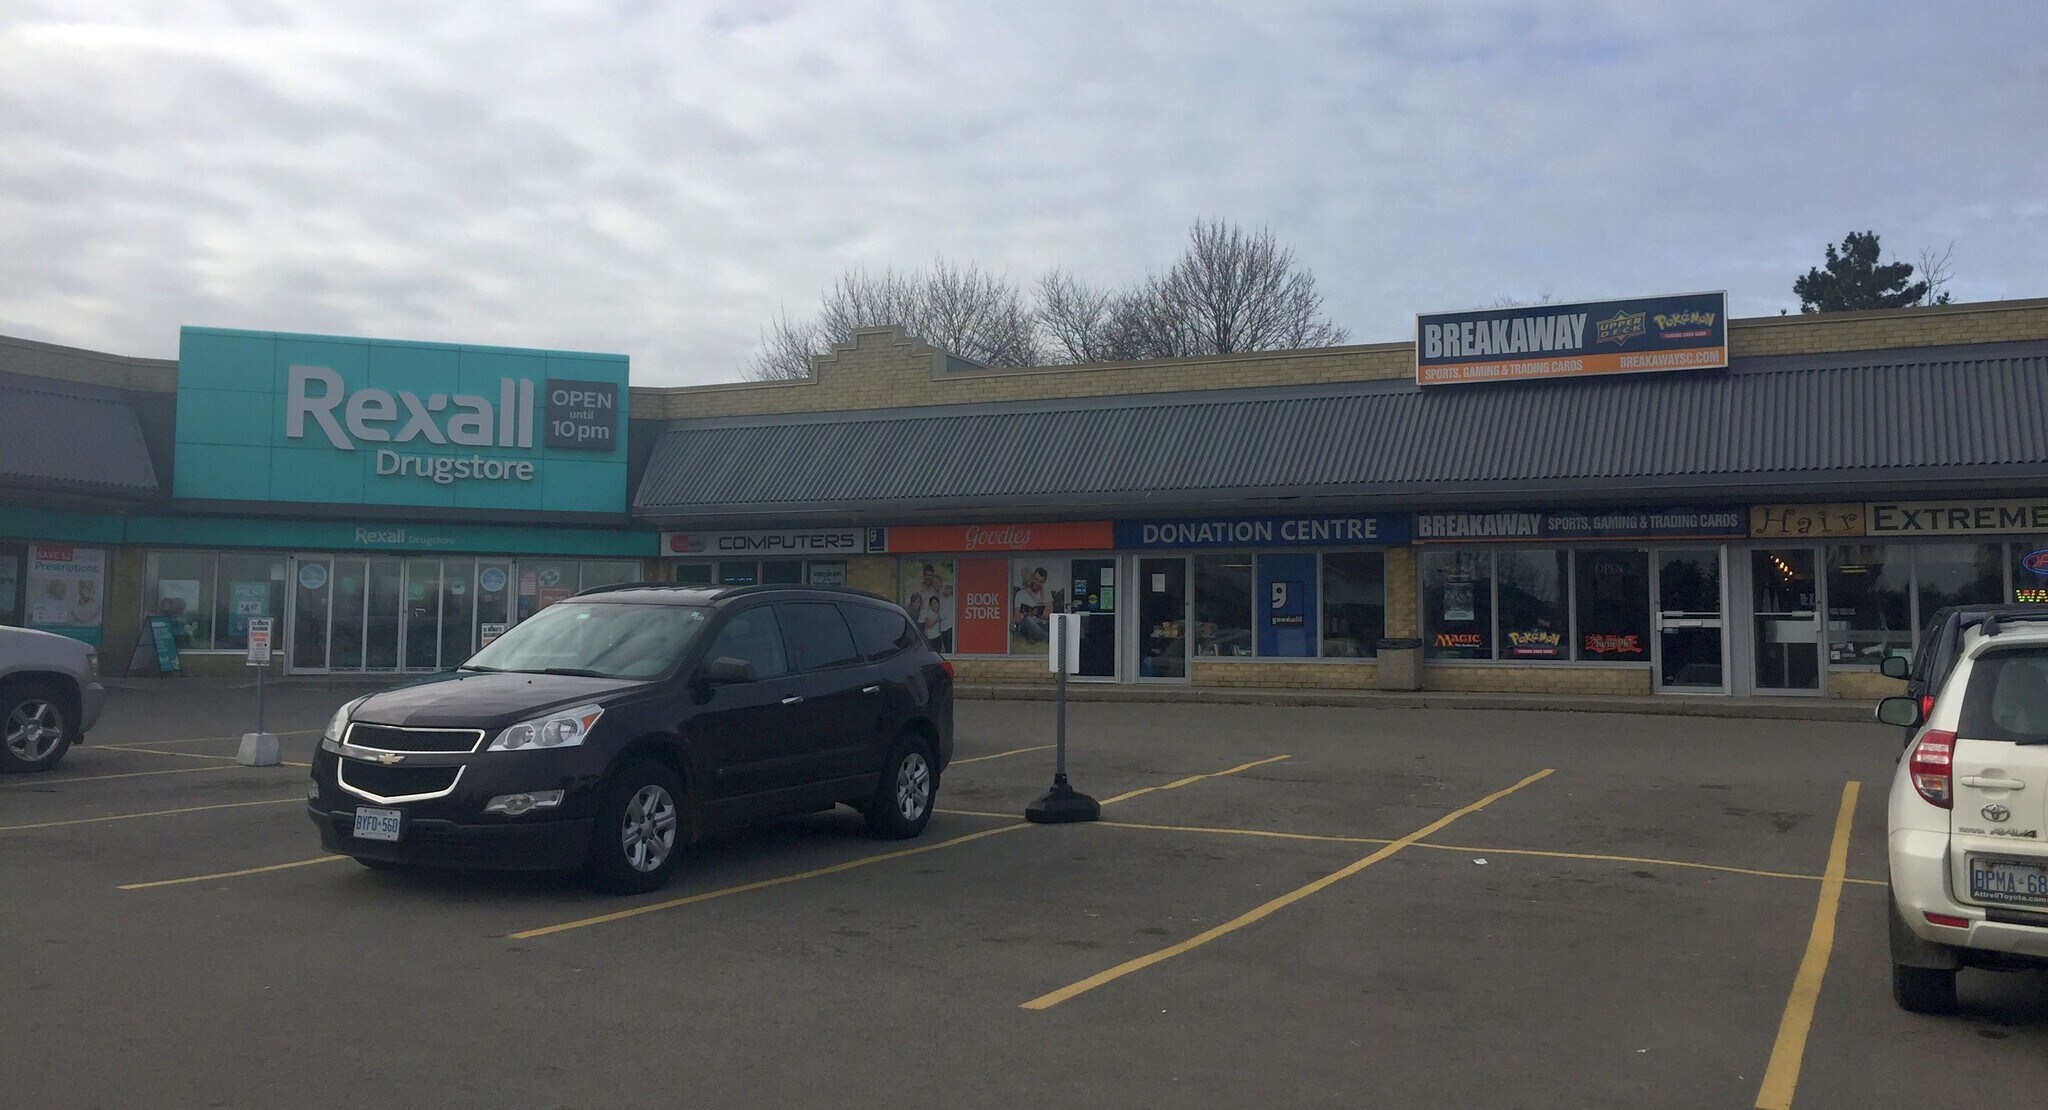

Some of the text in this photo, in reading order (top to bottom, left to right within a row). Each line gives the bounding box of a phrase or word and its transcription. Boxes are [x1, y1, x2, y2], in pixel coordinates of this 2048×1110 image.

[1600, 317, 1641, 331] UPPER
[1425, 313, 1588, 358] BREAKAWAY
[1620, 350, 1720, 369] BREAKAWAYSC.COM
[1425, 360, 1583, 380] SPORTS, GAMING & TRADING CARDS
[286, 364, 534, 451] Rexall
[552, 389, 612, 409] OPEN
[569, 410, 594, 420] until
[376, 450, 534, 484] Drugstore
[1418, 513, 1738, 537] BREAKAWAY SPORTS, GAMING & TRADING CARDS
[1756, 507, 1858, 534] Hair
[355, 527, 405, 544] Rexall
[965, 525, 1030, 551] Goodies
[1143, 518, 1377, 544] DONATION CENTRE
[719, 533, 854, 550] COMPUTERS
[1594, 563, 1624, 575] OPEN
[966, 592, 999, 606] BOOK
[965, 607, 1000, 620] STORE
[1958, 827, 1986, 835] TOYOTA
[1974, 869, 2016, 893] BPMA
